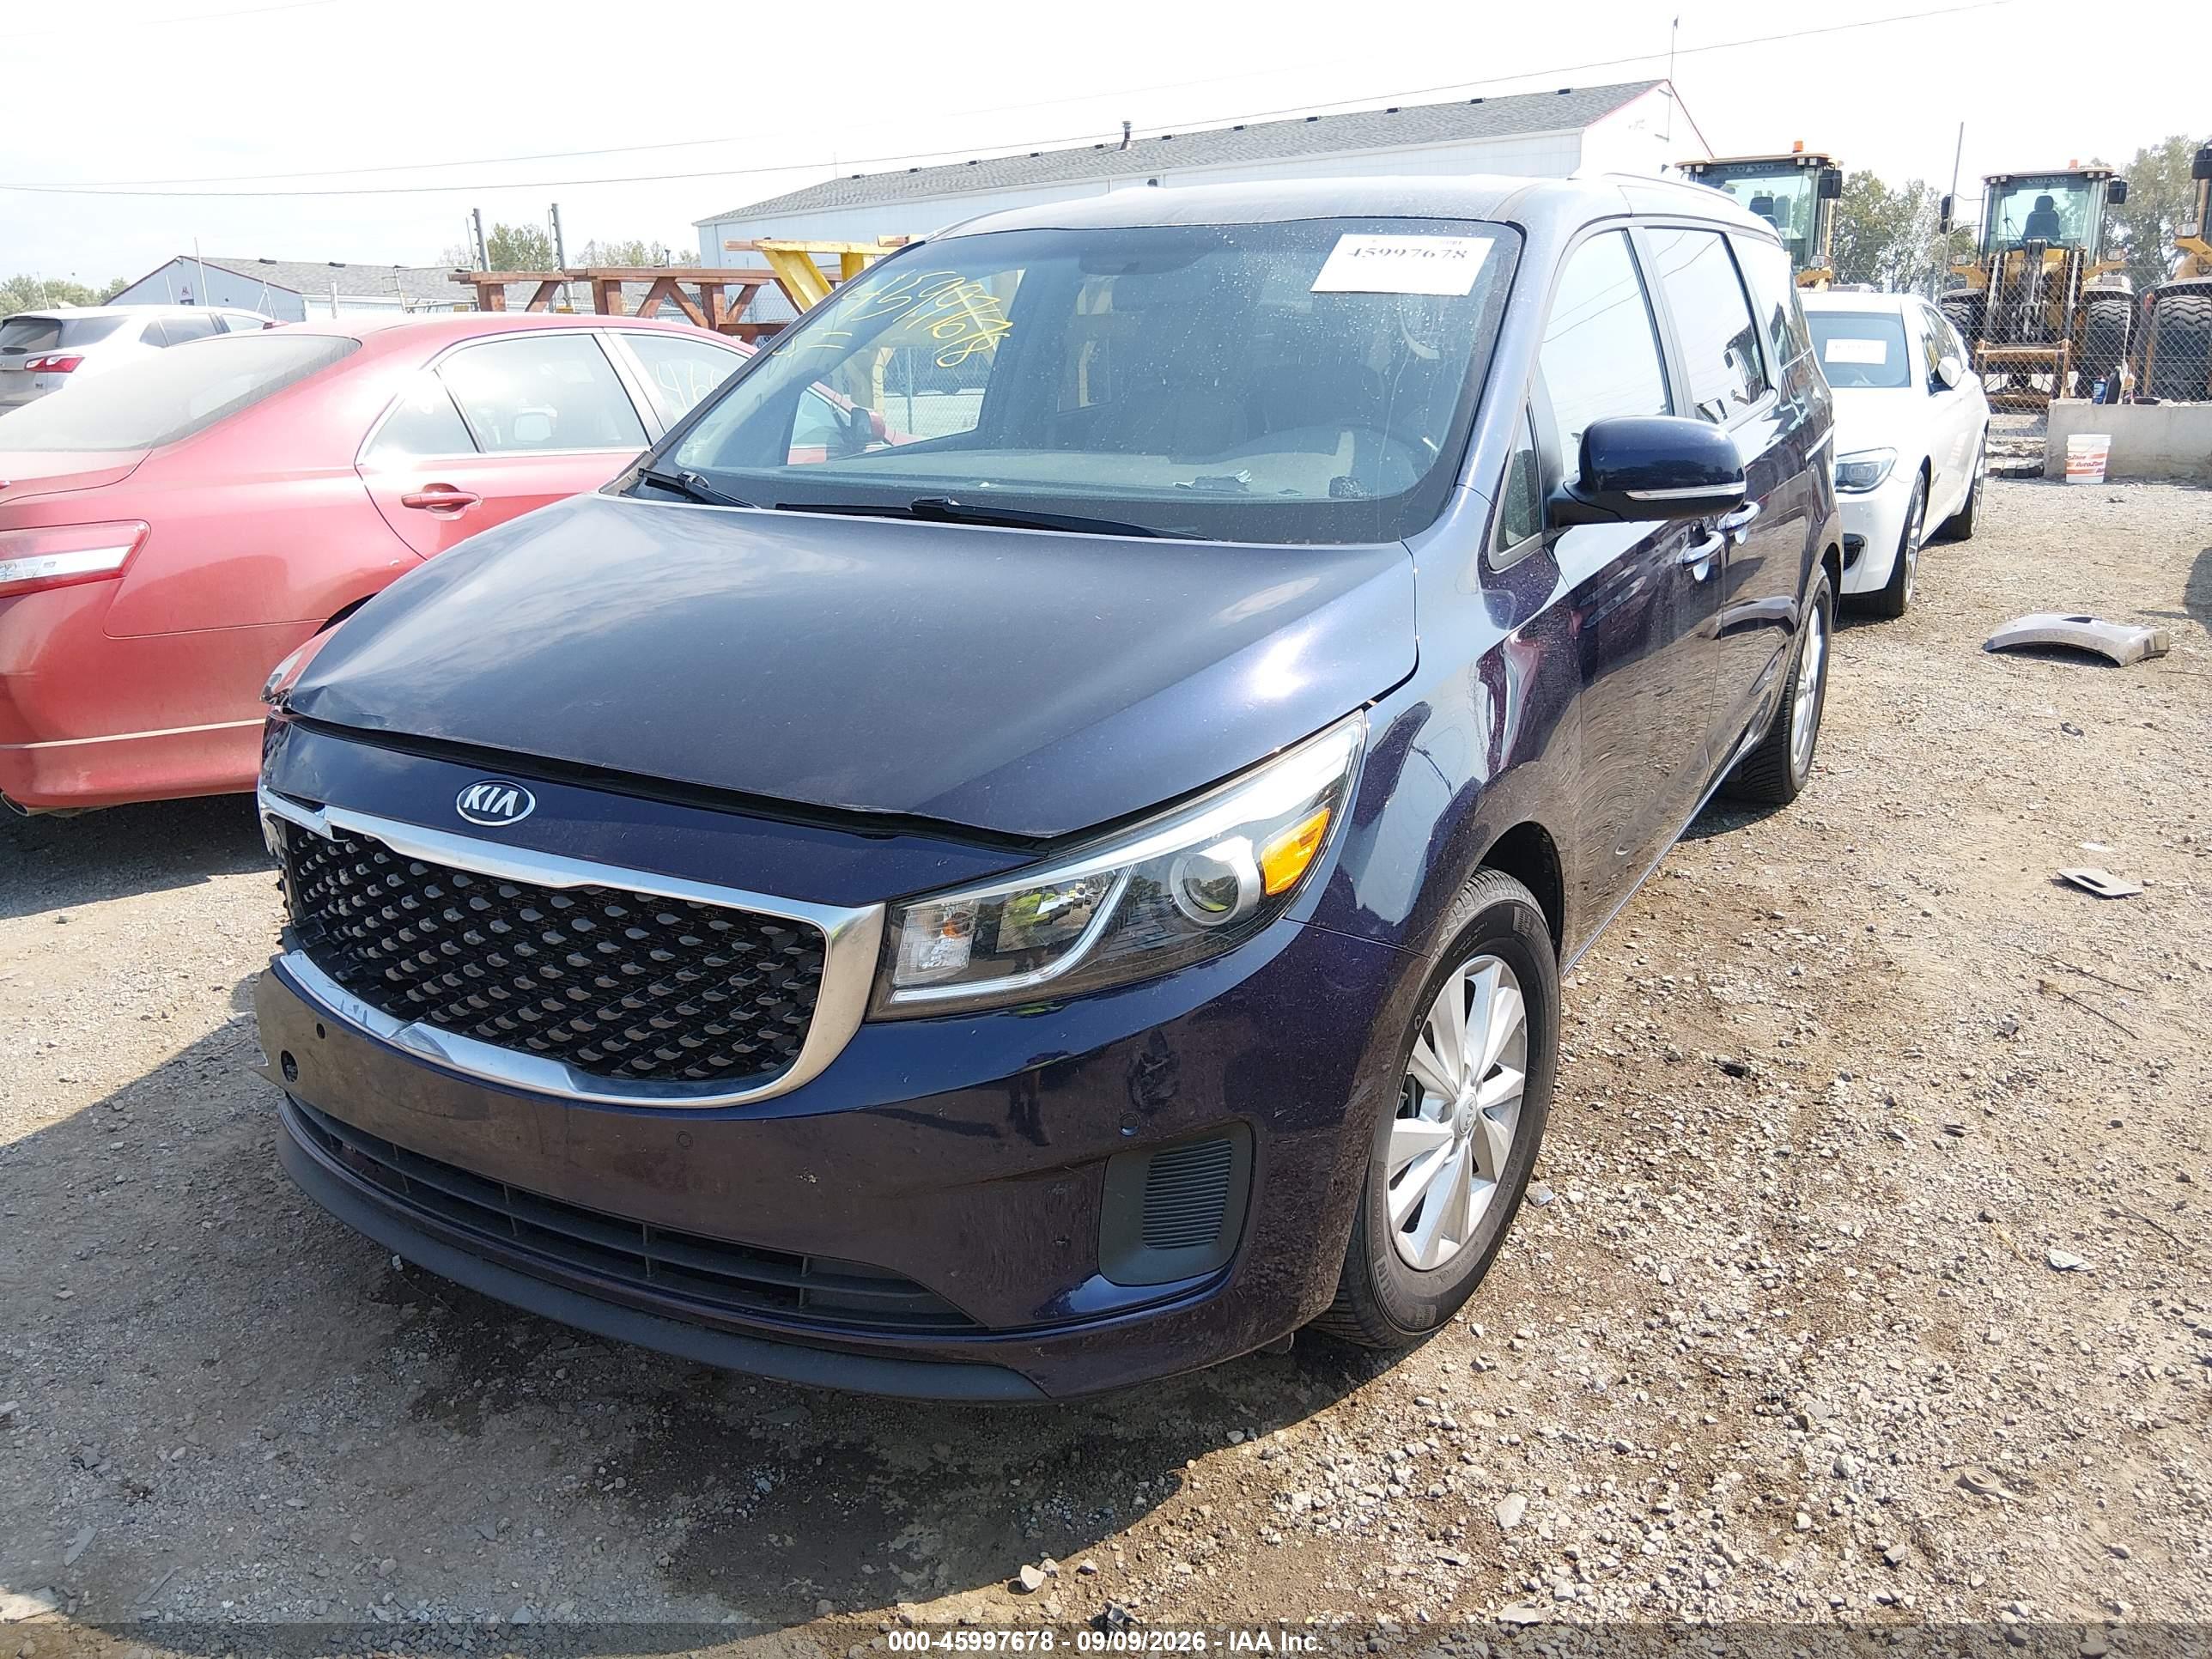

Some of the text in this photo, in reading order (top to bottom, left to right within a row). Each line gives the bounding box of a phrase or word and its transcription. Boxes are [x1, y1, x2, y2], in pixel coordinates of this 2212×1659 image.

[1726, 164, 1774, 173] VOVO
[1347, 247, 1468, 258] 45997678
[463, 785, 519, 817] KIA
